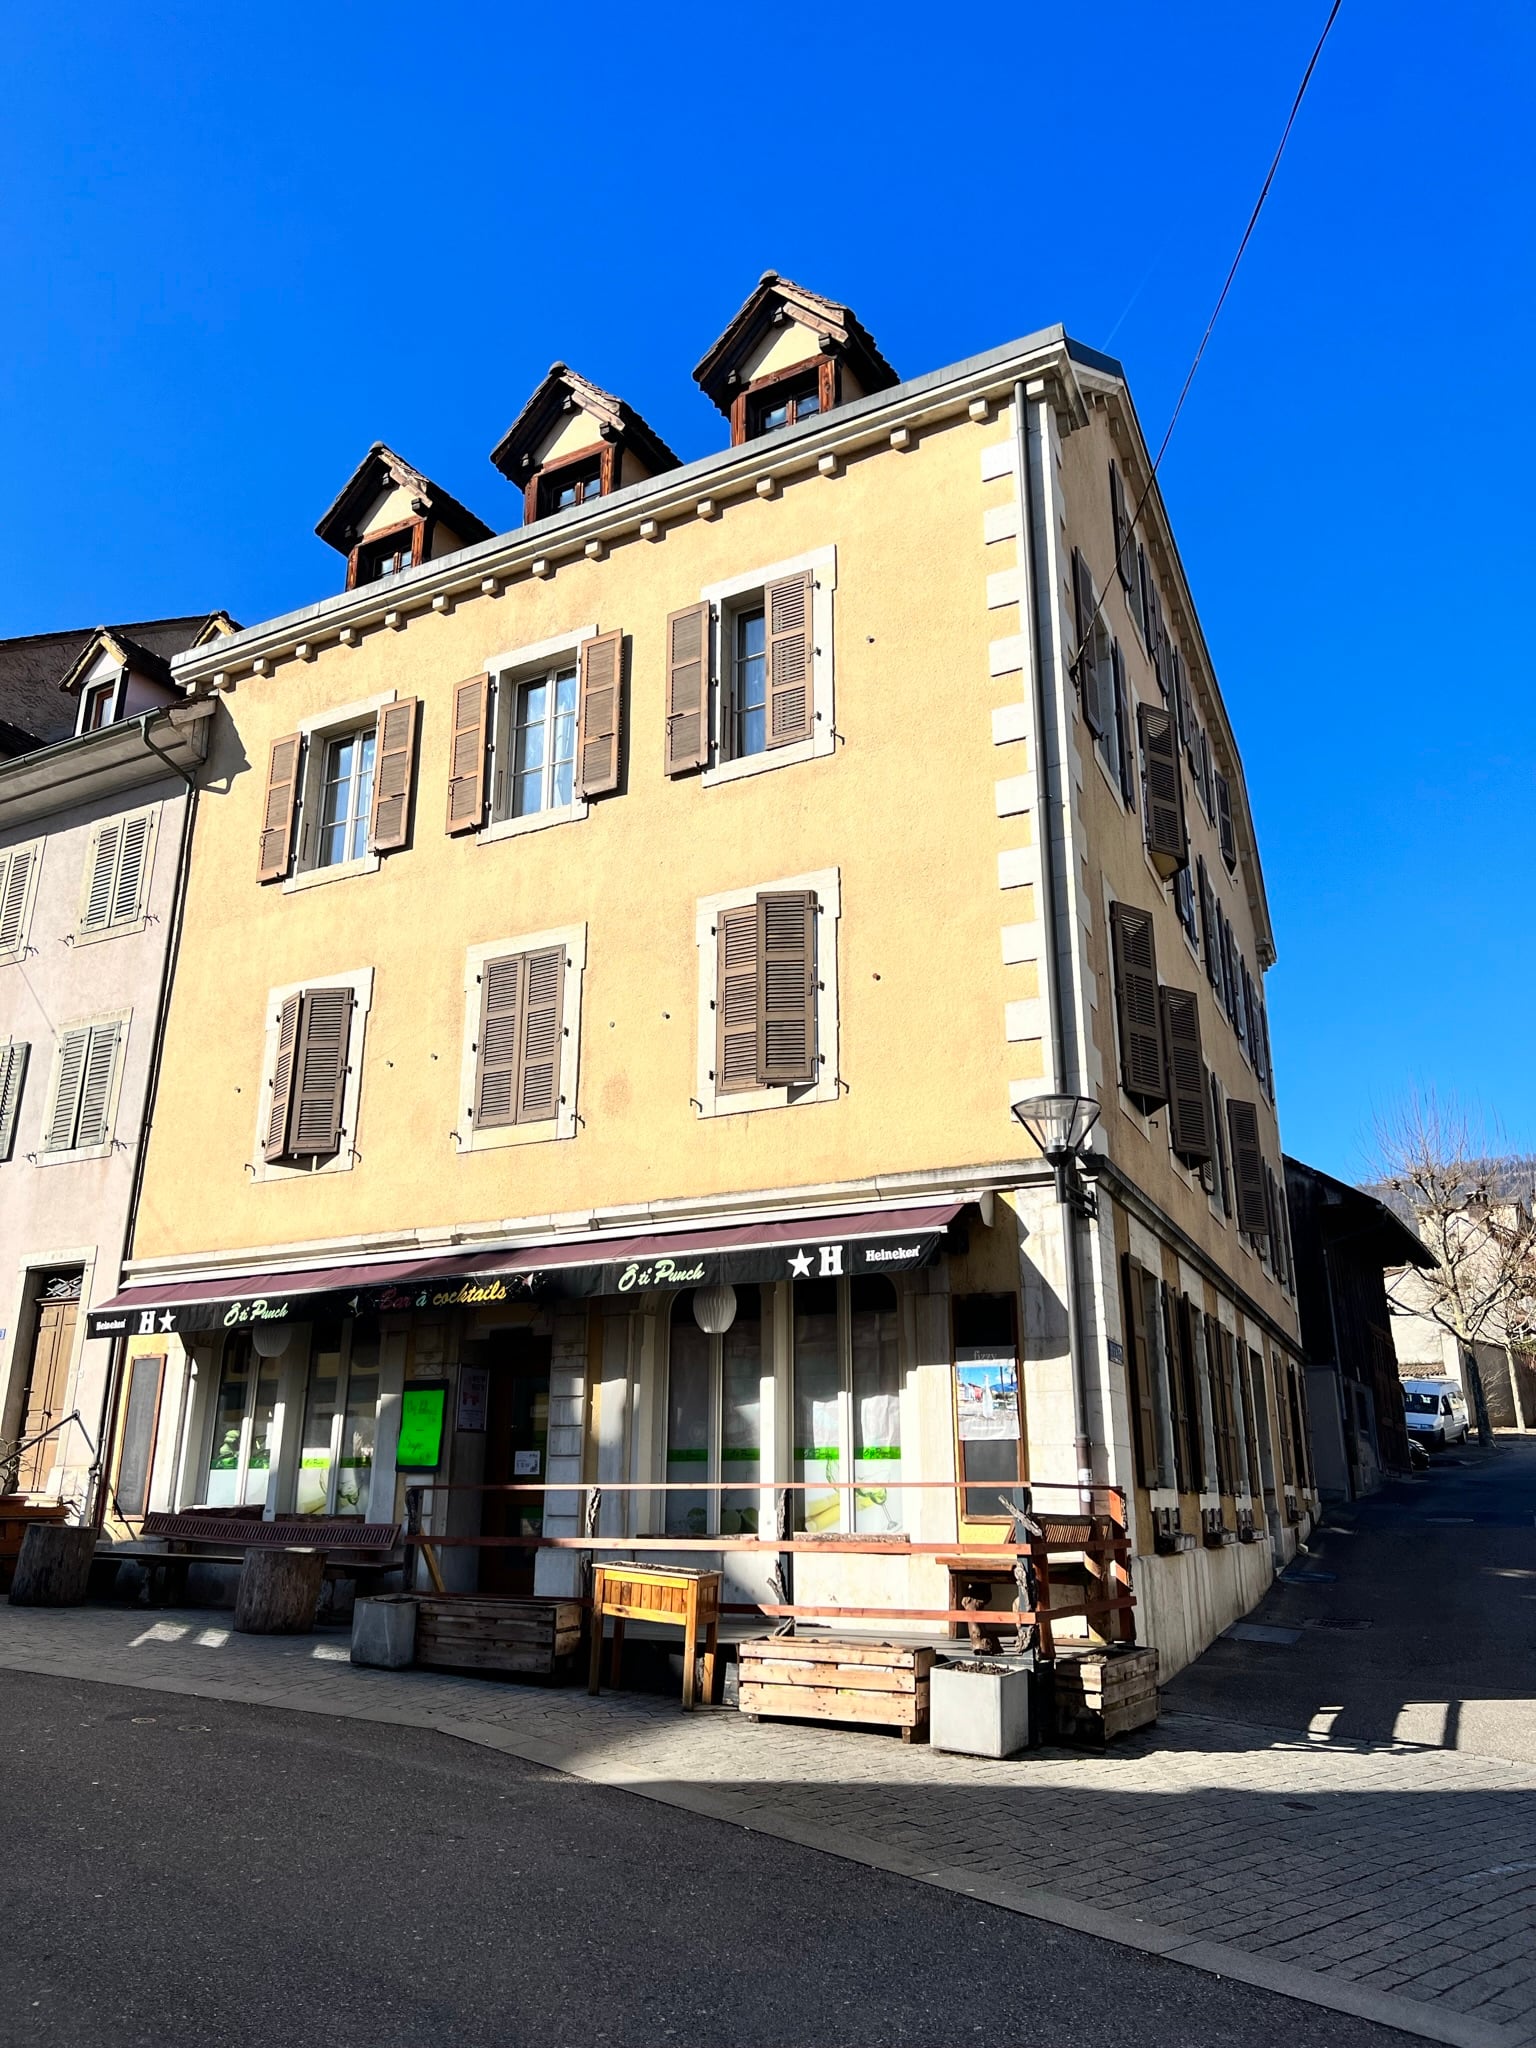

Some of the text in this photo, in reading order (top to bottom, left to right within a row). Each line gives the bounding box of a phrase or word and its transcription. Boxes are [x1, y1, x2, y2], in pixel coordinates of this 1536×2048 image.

[818, 1245, 844, 1276] H
[865, 1244, 921, 1262] Heineken
[638, 1271, 651, 1285] ti
[654, 1259, 705, 1285] Punch
[379, 1287, 411, 1310] Bar
[432, 1279, 507, 1305] cocktails
[238, 1307, 248, 1321] ti
[249, 1299, 289, 1320] Punch
[95, 1318, 127, 1331] Heineken
[138, 1311, 156, 1334] H
